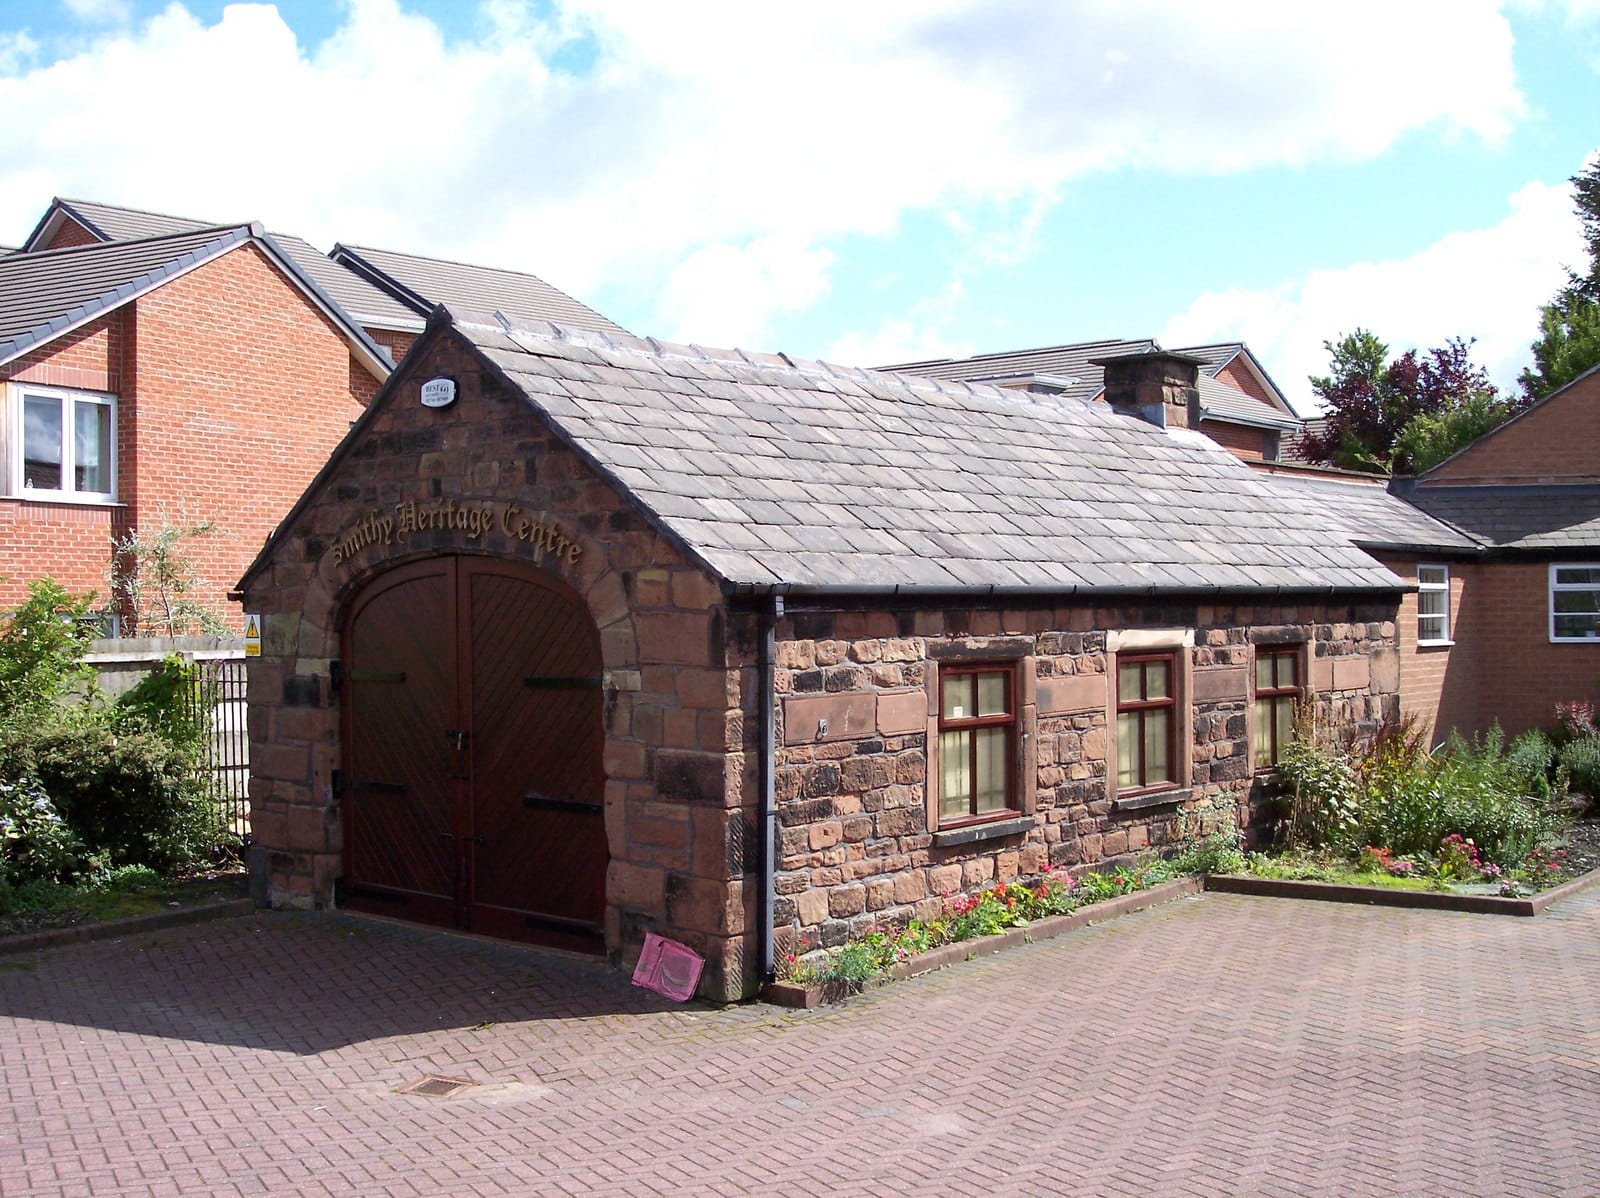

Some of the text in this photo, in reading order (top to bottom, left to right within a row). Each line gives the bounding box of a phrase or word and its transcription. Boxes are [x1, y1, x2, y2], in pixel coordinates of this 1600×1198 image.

[331, 497, 582, 568] Smithy Heritage Centre
